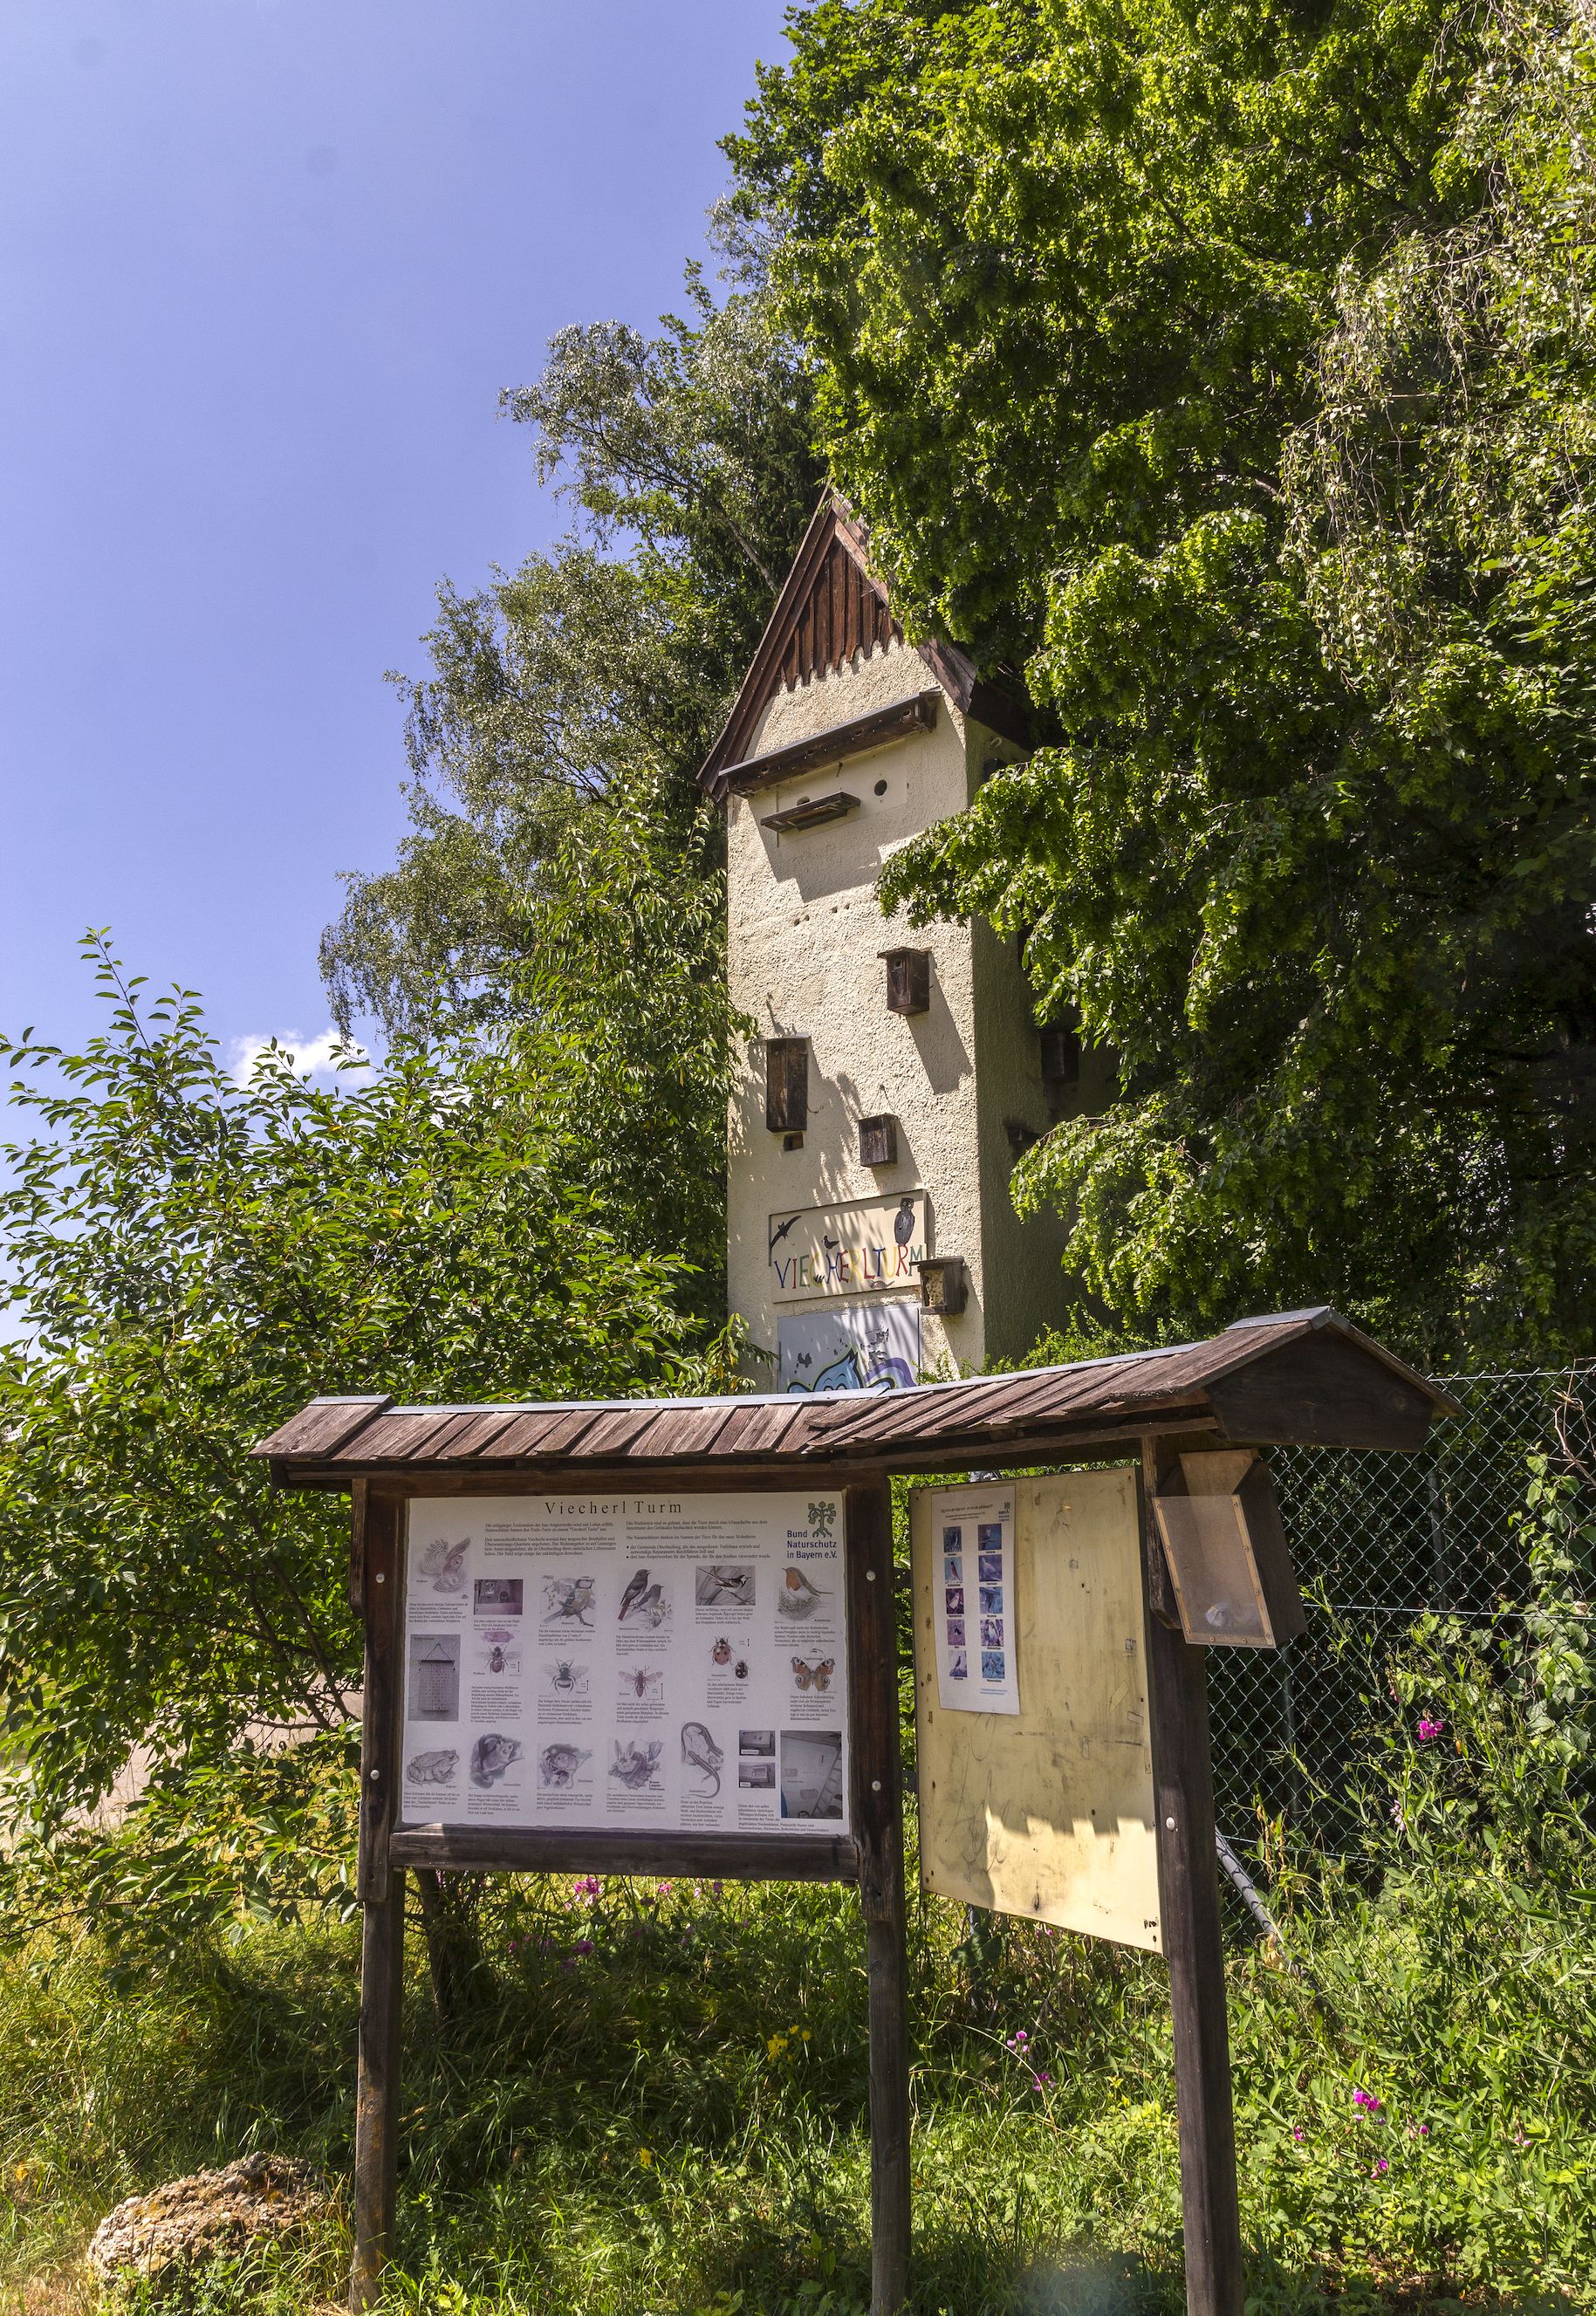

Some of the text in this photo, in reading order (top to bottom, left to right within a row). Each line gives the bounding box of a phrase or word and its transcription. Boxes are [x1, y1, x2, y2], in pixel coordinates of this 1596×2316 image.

[545, 1500, 682, 1515] Viecherl Turm
[786, 1529, 808, 1538] Bund
[786, 1540, 838, 1549] Naturschutz
[786, 1550, 838, 1560] in Bayern e.V.
